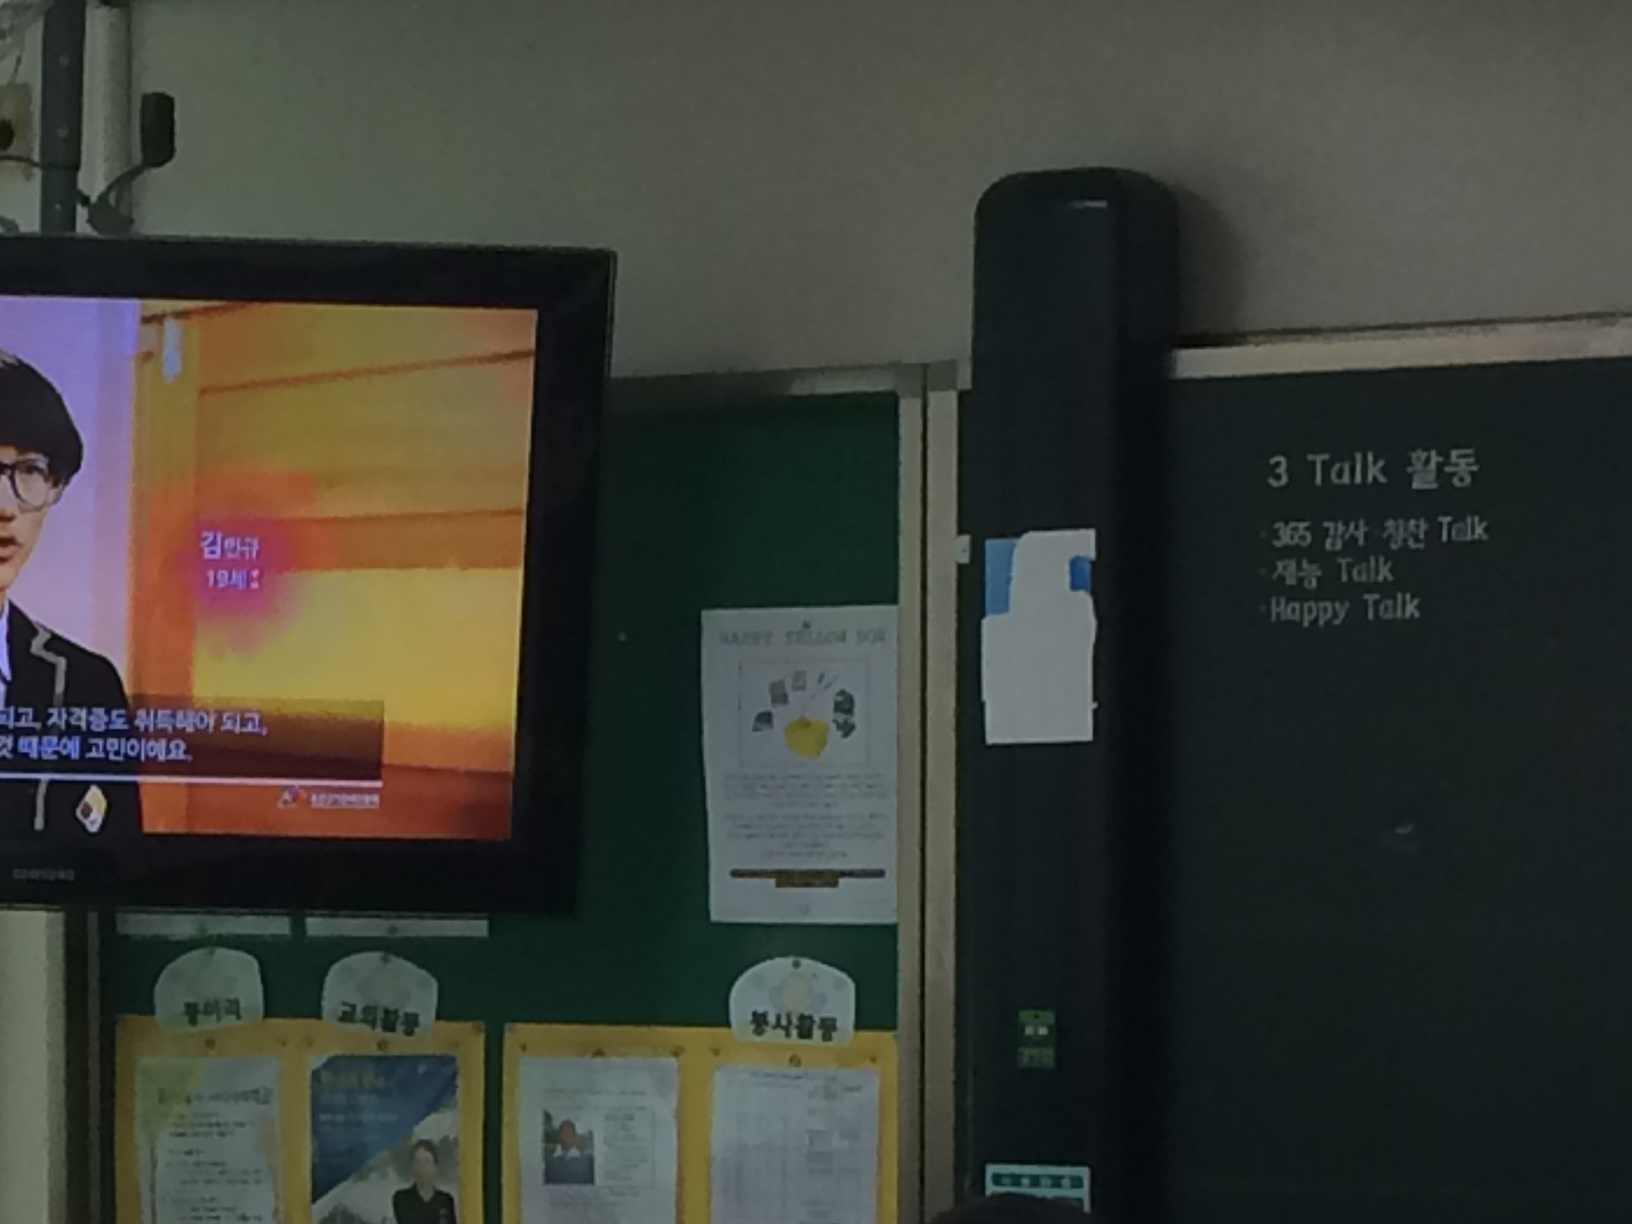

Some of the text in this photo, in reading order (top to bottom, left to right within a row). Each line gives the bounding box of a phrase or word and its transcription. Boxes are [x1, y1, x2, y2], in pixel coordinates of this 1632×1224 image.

[1267, 447, 1480, 490] 3 Talk 활동
[1272, 515, 1489, 551] 365 감사 칭찬 Talk
[1272, 555, 1394, 589] 재능 Talk
[1270, 592, 1421, 628] Happy Talk
[47, 706, 129, 732] 자격증도
[18, 735, 80, 760] 때문에
[750, 1009, 840, 1042] 봉사활동
